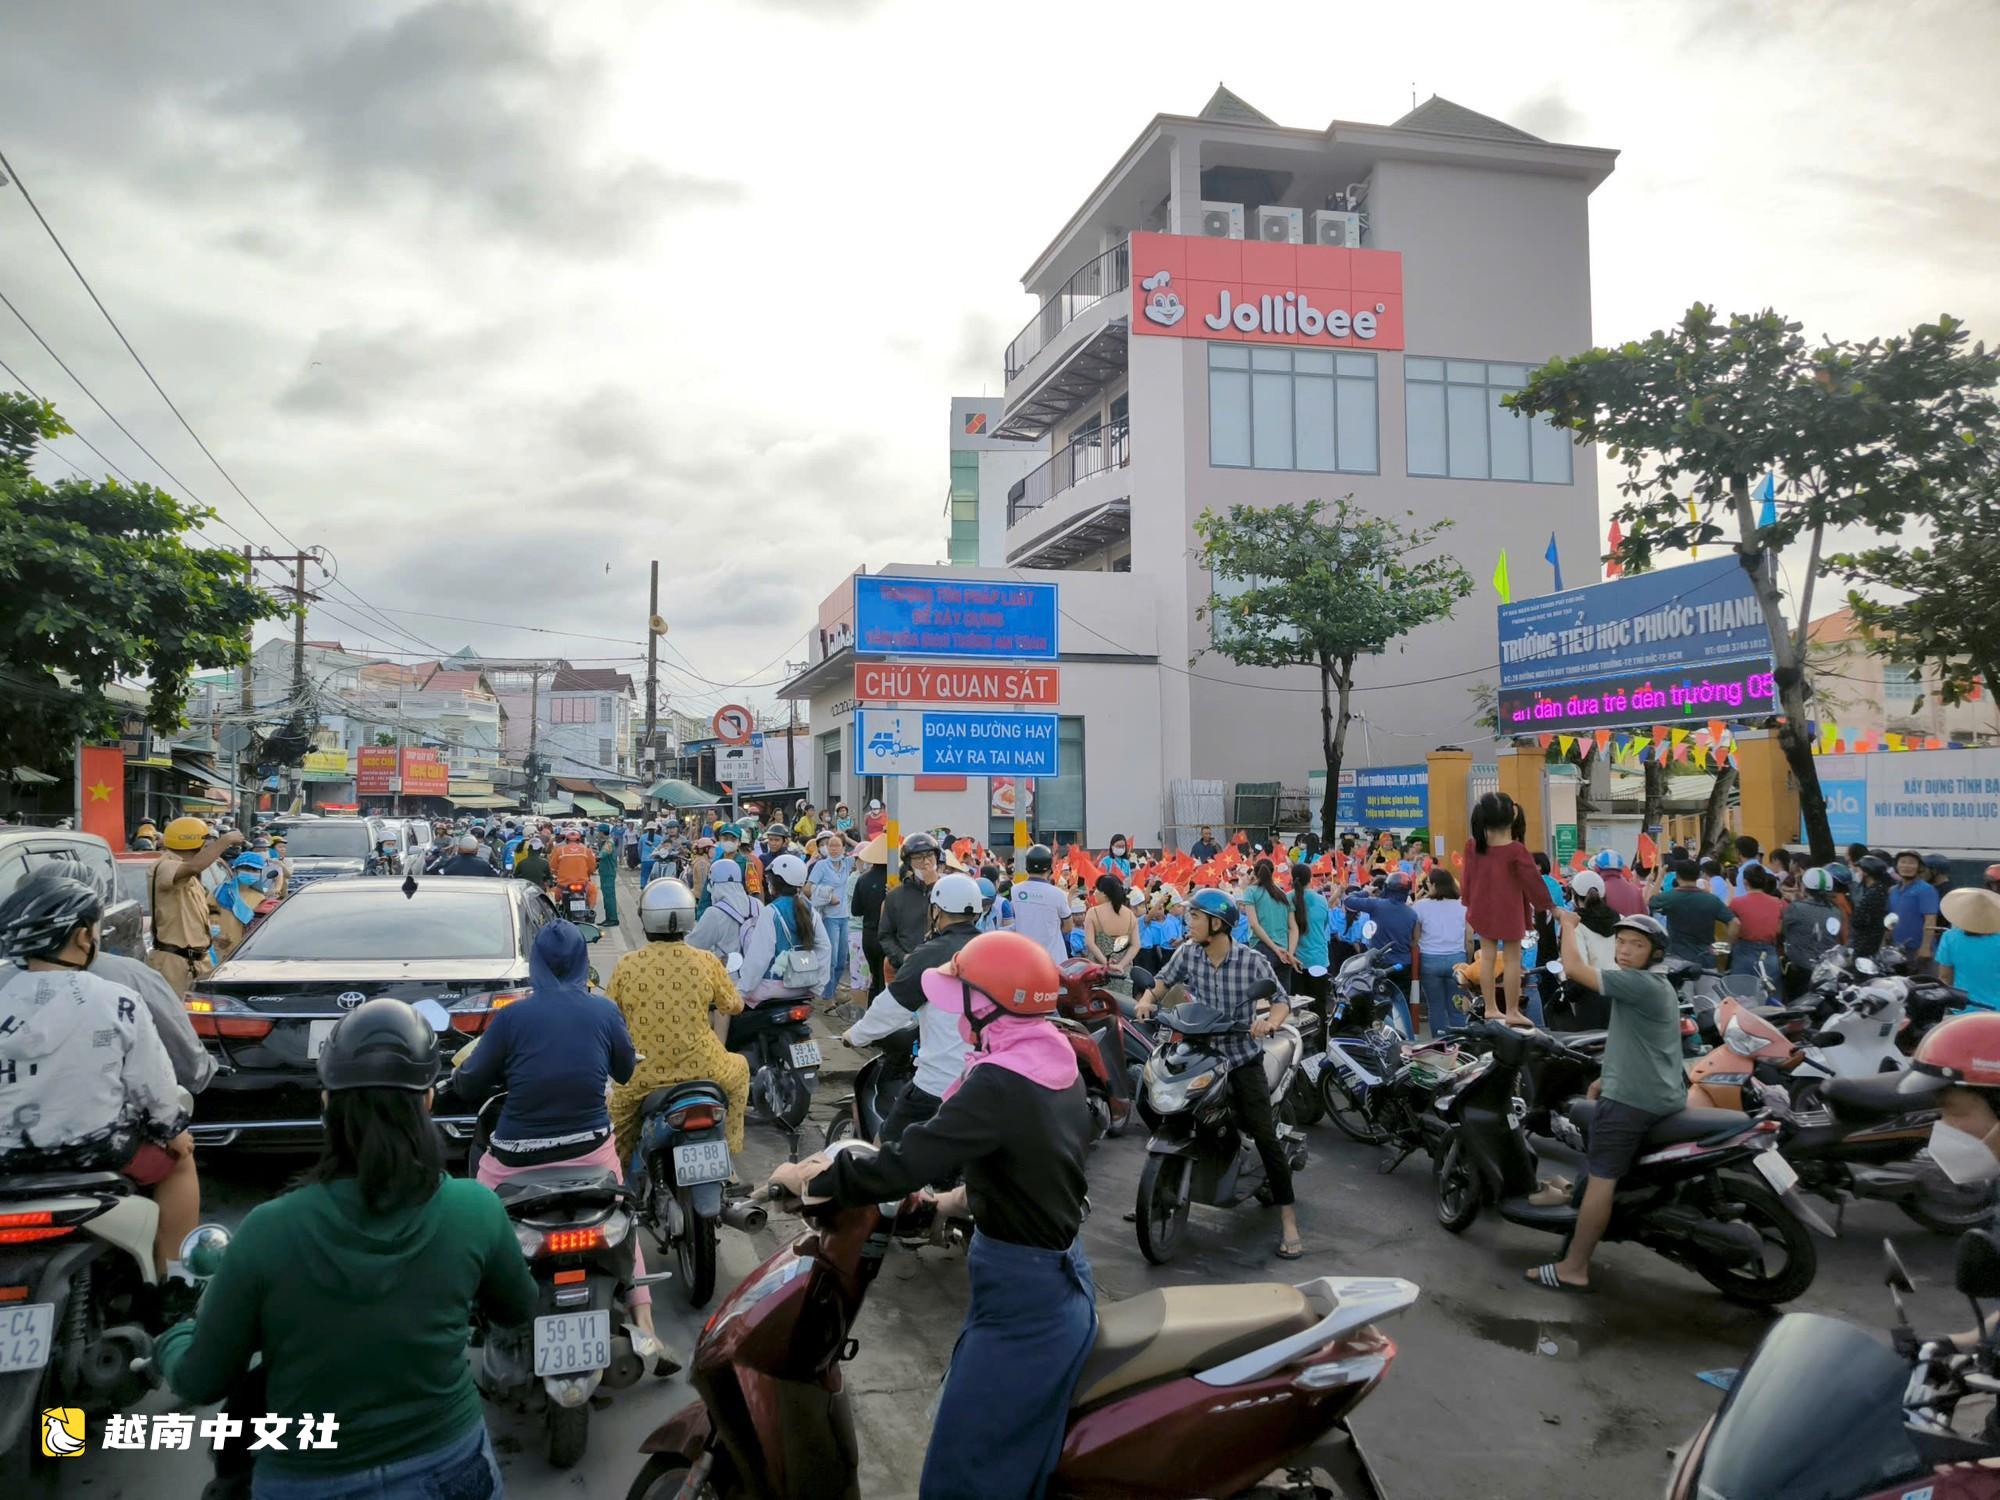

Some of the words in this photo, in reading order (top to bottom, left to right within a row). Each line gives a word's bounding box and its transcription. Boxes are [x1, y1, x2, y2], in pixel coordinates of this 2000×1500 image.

[1204, 289, 1377, 339] Jollibee
[1502, 626, 1557, 663] TRƯỜNG
[1558, 611, 1594, 655] TIỂU
[1596, 619, 1631, 655] HỌC
[1634, 595, 1694, 644] PHƯỚC
[1696, 596, 1763, 637] THẠNH
[866, 667, 910, 696] CHÚ
[919, 667, 931, 697] Ý
[936, 673, 998, 698] QUAN
[1005, 669, 1049, 699] SÁT
[1671, 680, 1742, 706] trường
[925, 722, 966, 741] ĐOẠN
[970, 720, 1021, 738] ĐƯỜNG
[1025, 725, 1052, 739] HAY
[935, 744, 963, 764] XẢY
[968, 750, 986, 764] RA
[989, 750, 1010, 765] TAI
[1015, 752, 1045, 769] NẠN
[1925, 779, 1953, 797] DỰNG
[1957, 775, 1982, 795] TÌNH
[1952, 803, 1974, 821] BẠO
[1977, 802, 1998, 822] LỰC
[681, 1144, 719, 1164] 63-B8
[546, 1316, 596, 1343] 59-V1
[538, 1340, 605, 1373] 738.58
